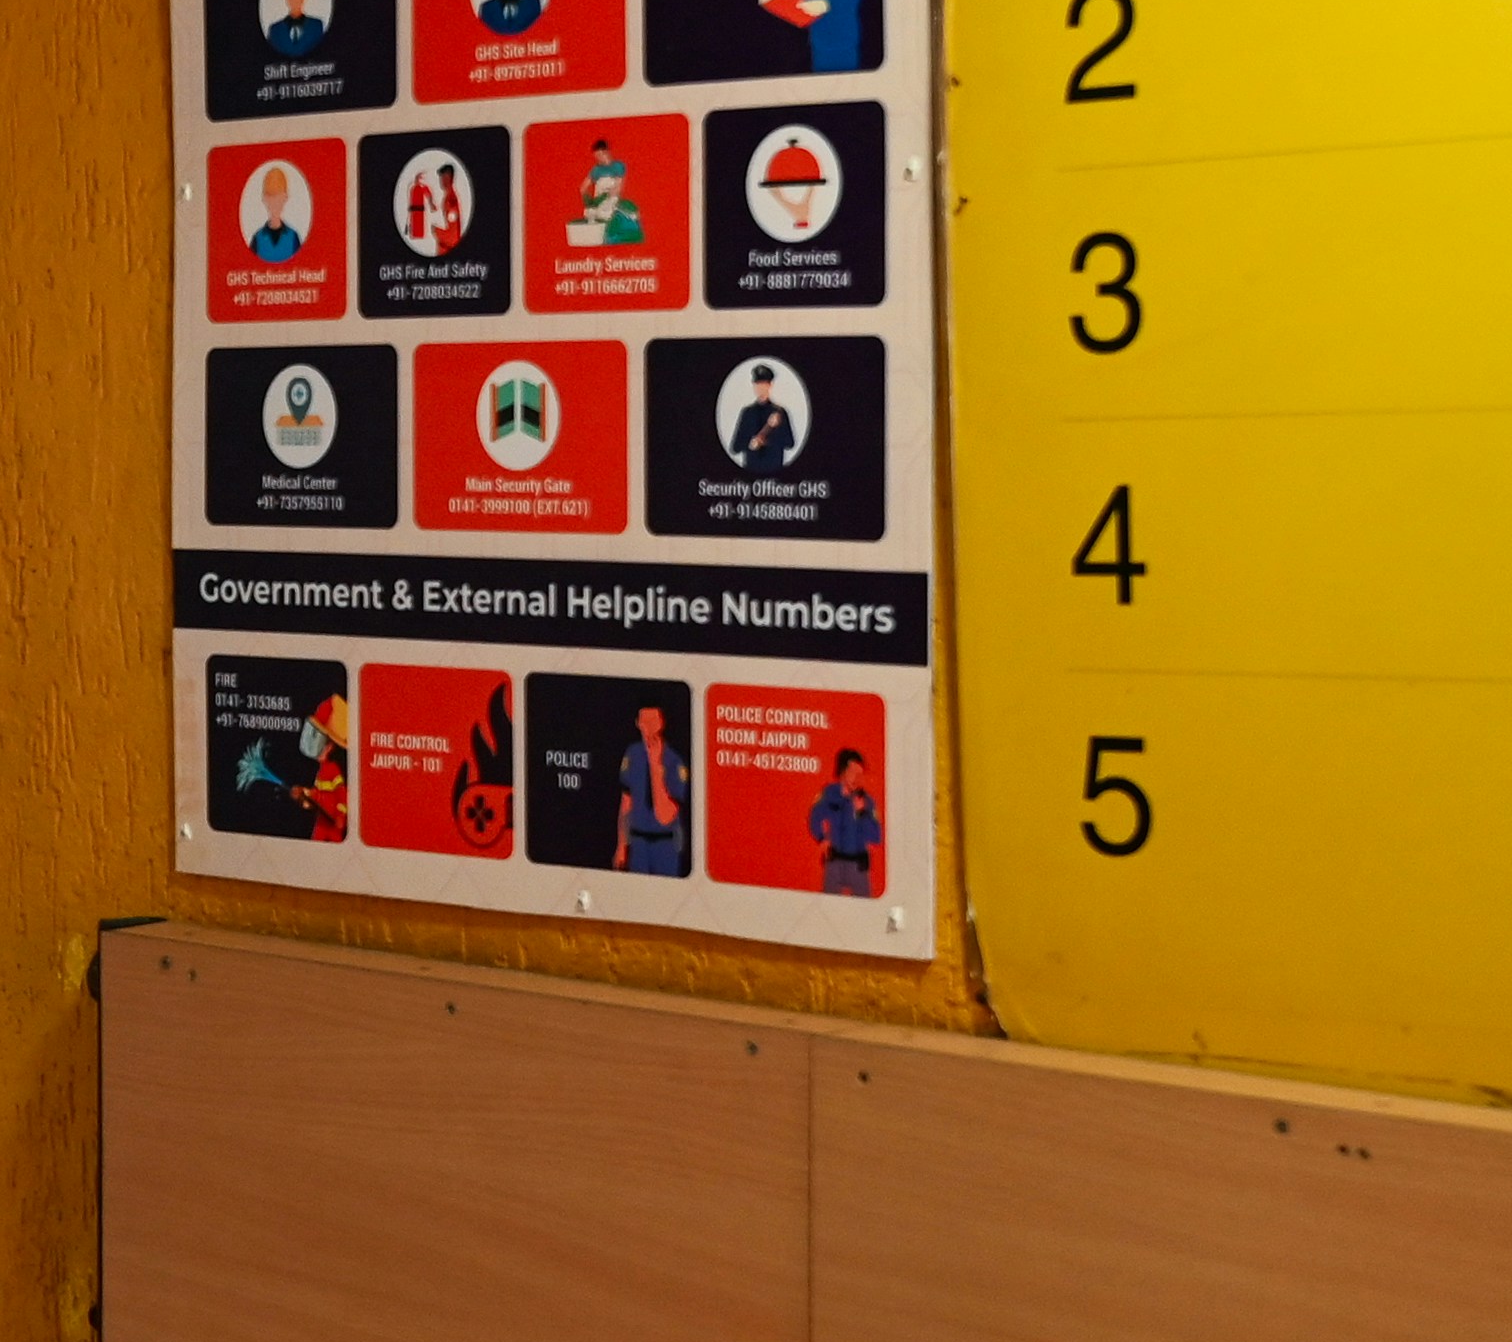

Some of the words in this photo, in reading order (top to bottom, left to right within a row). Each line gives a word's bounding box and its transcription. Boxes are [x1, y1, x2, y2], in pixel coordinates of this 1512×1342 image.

[475, 44, 499, 60] GHS
[502, 42, 524, 58] Site
[527, 39, 557, 57] Head
[264, 64, 288, 80] Shift
[290, 61, 334, 82] Engineer
[555, 258, 602, 276] Laundry
[604, 256, 656, 272] Services
[748, 250, 779, 266] Food
[783, 249, 837, 266] Services
[227, 272, 249, 286] GHS
[251, 270, 296, 285] Technical
[298, 268, 325, 283] Head
[379, 266, 402, 281] GHS
[405, 264, 425, 279] Fire
[427, 263, 449, 278] And
[451, 262, 488, 282] Safety
[1069, 232, 1144, 355] 3
[261, 474, 301, 491] Medical
[303, 475, 337, 491] Center
[465, 477, 493, 492] Main
[495, 477, 542, 497] Security
[544, 478, 571, 493] Gate
[698, 479, 749, 500] Security
[752, 479, 794, 497] Officer
[798, 481, 827, 499] GHS
[1071, 485, 1148, 606] 4
[200, 573, 382, 610] Government
[392, 581, 414, 610] &
[423, 580, 555, 617] External
[567, 585, 710, 628] Helpline
[721, 594, 894, 633] Numbers
[215, 672, 238, 688] FIRE
[716, 705, 762, 724] POLICE
[765, 708, 829, 729] CONTROL
[370, 731, 393, 747] FIRE
[396, 733, 450, 754] CONTROL
[716, 728, 755, 745] ROOM
[758, 730, 807, 750] JAIPUR
[370, 753, 411, 770] JAIPUR
[422, 757, 440, 772] 101
[546, 750, 589, 768] POLICE
[557, 772, 579, 789] 100
[1080, 736, 1153, 856] 5
